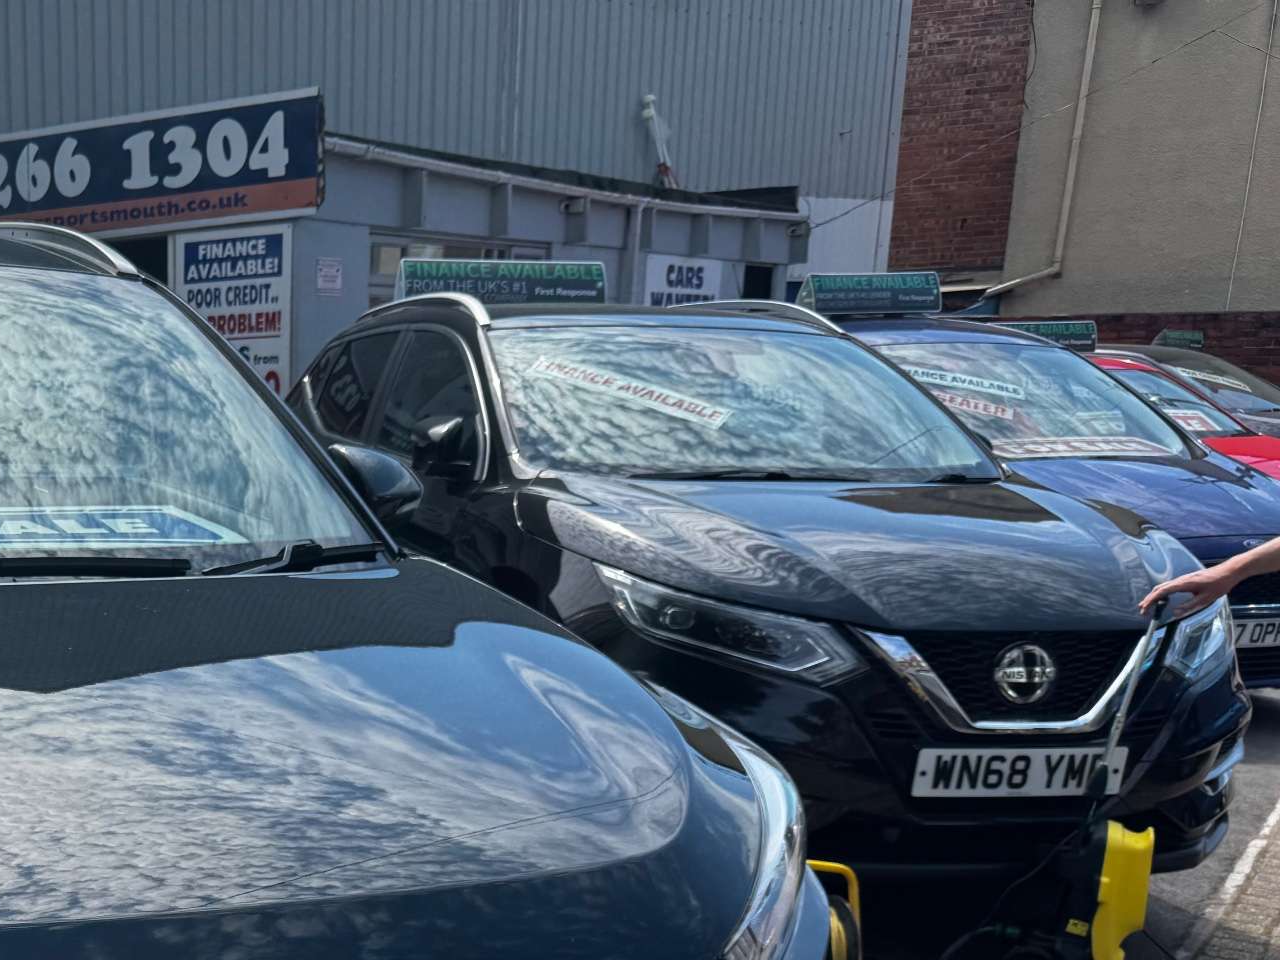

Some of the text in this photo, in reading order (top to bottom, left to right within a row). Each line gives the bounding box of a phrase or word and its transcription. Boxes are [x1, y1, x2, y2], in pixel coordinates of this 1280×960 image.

[122, 110, 289, 190] 1304
[198, 239, 266, 261] FINANCE
[187, 259, 279, 281] AVAILABLE!
[405, 262, 603, 280] FINANCE AVAILABLE
[666, 264, 704, 289] CARS
[406, 280, 443, 293] FROM
[449, 280, 472, 293] THE
[534, 287, 554, 296] First
[187, 288, 221, 308] POOR
[208, 311, 281, 335] PROBLEM!
[254, 355, 279, 365] from
[539, 359, 721, 421] FINANCE AVAILABLE
[951, 375, 1021, 396] AVAILABLE
[931, 754, 1029, 790] WN68
